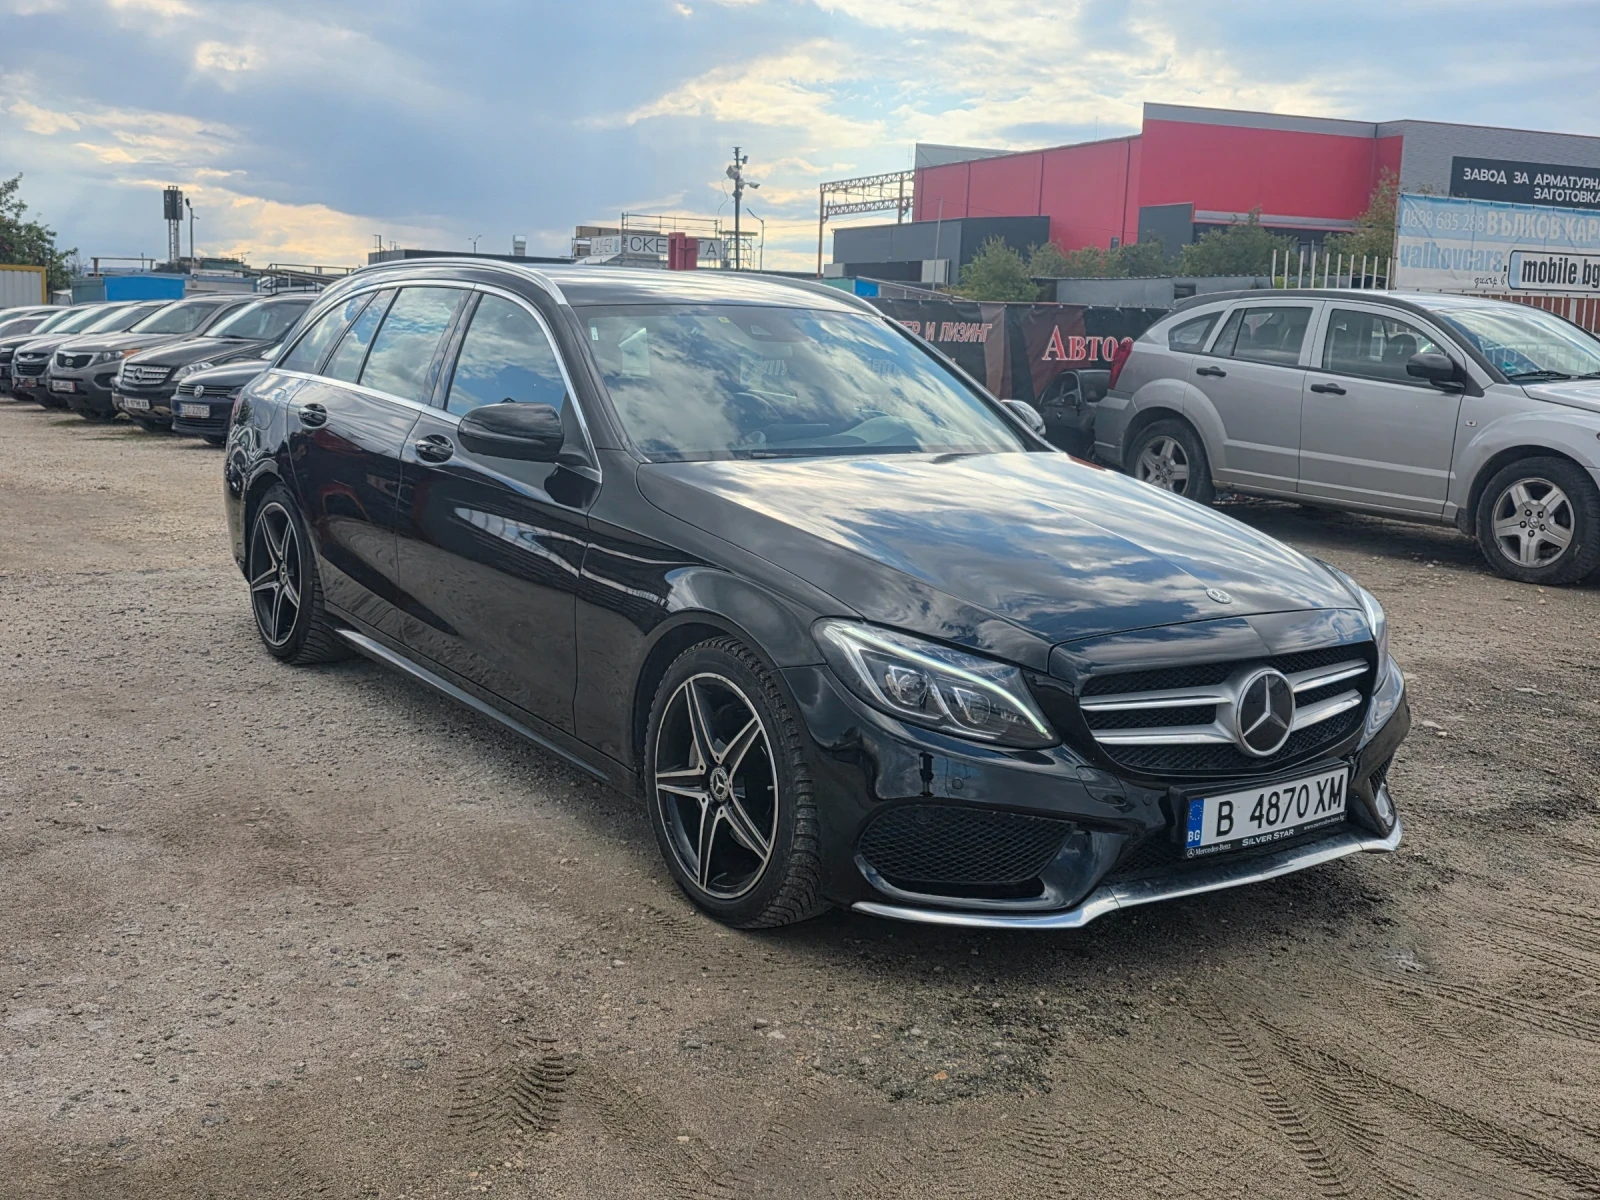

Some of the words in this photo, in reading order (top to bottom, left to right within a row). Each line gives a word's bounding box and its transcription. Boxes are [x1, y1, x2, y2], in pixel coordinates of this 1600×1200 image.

[1463, 168, 1507, 185] ЗАВОД
[1513, 171, 1529, 185] ЗА
[1402, 208, 1433, 228] 0898
[1436, 211, 1459, 231] 685
[1461, 214, 1485, 232] 288
[1486, 210, 1561, 240] ВЪЛКОВ
[1564, 217, 1600, 242] КАР
[1521, 256, 1600, 289] mobile.bg
[925, 321, 936, 342] И
[938, 321, 993, 343] ЛИЗИНГ
[1215, 800, 1234, 838] B
[1249, 783, 1310, 829] 4870
[1313, 774, 1344, 815] XM
[1187, 829, 1200, 842] BG
[1273, 828, 1294, 841] STAR
